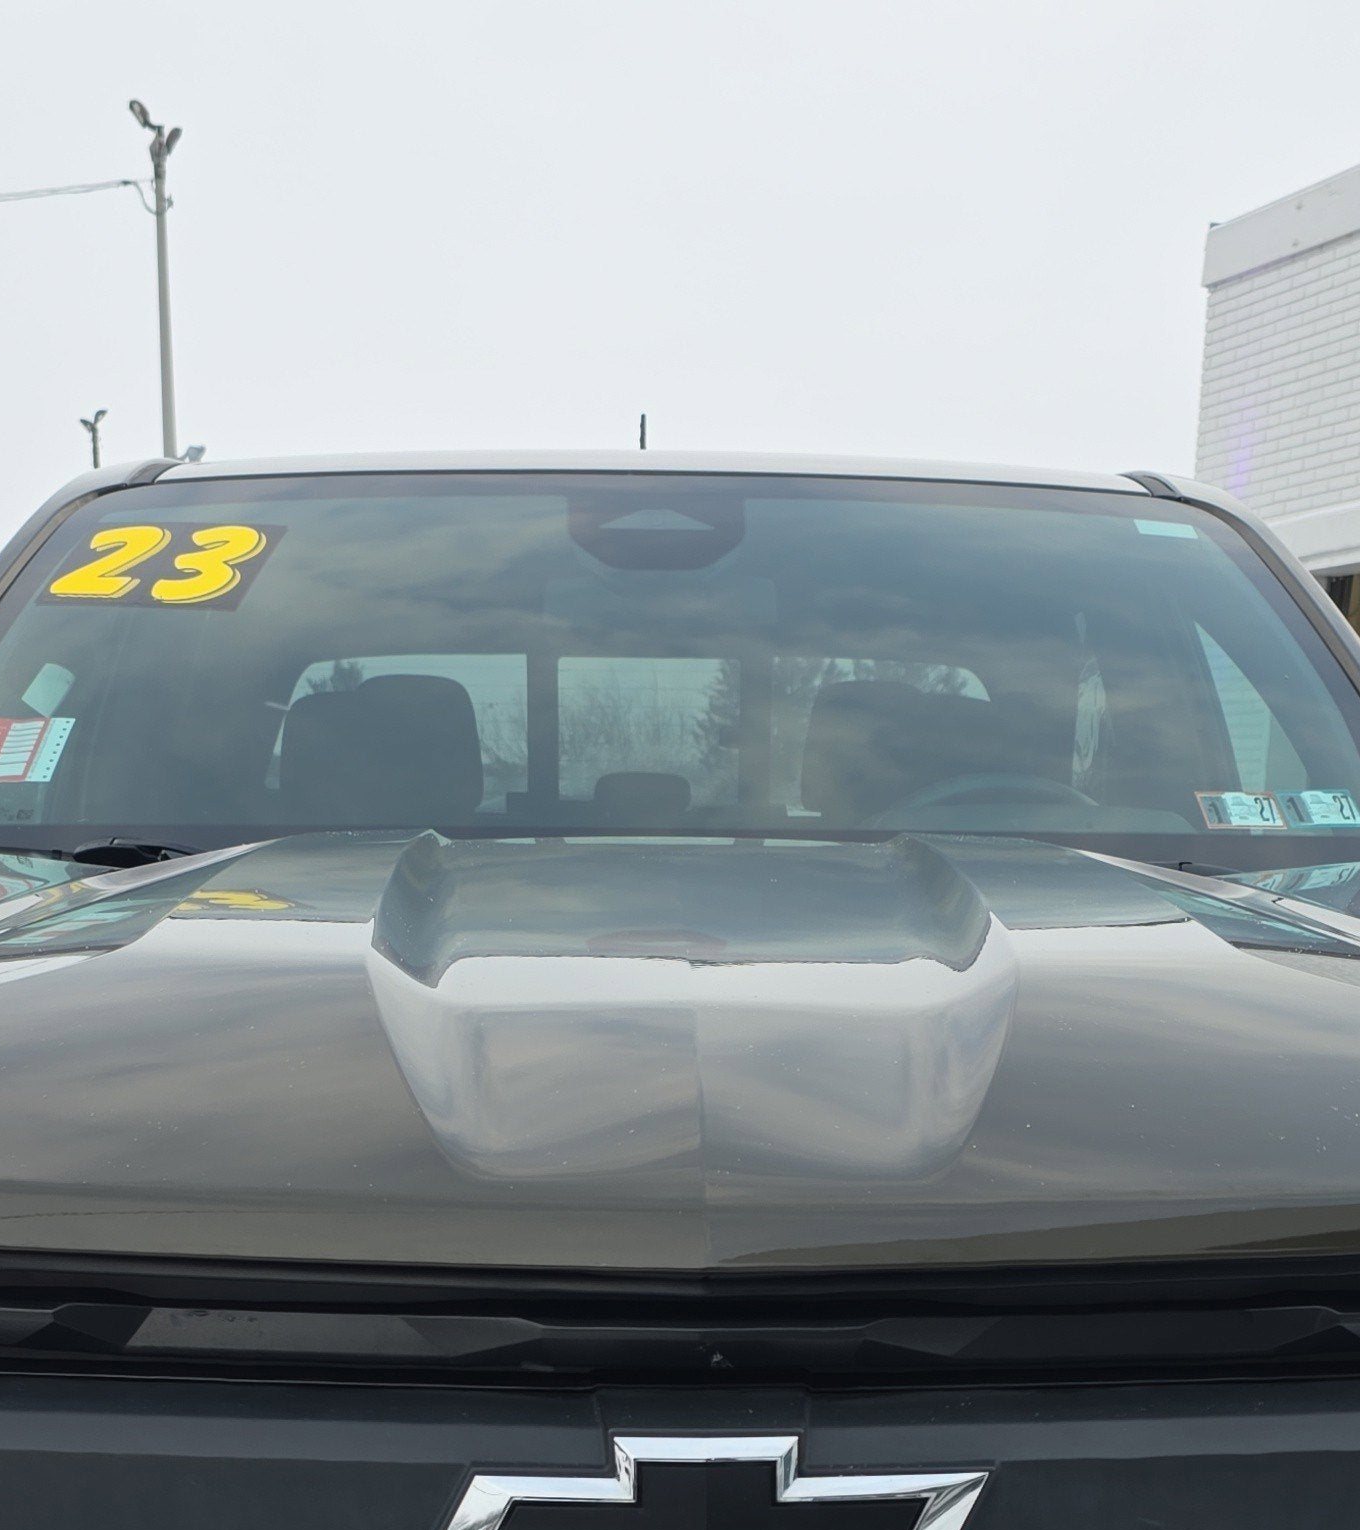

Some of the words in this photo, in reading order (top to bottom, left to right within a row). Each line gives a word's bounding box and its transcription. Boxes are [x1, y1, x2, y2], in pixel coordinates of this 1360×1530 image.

[50, 525, 267, 604] 23
[1252, 797, 1276, 824] 27
[1332, 795, 1357, 821] 27
